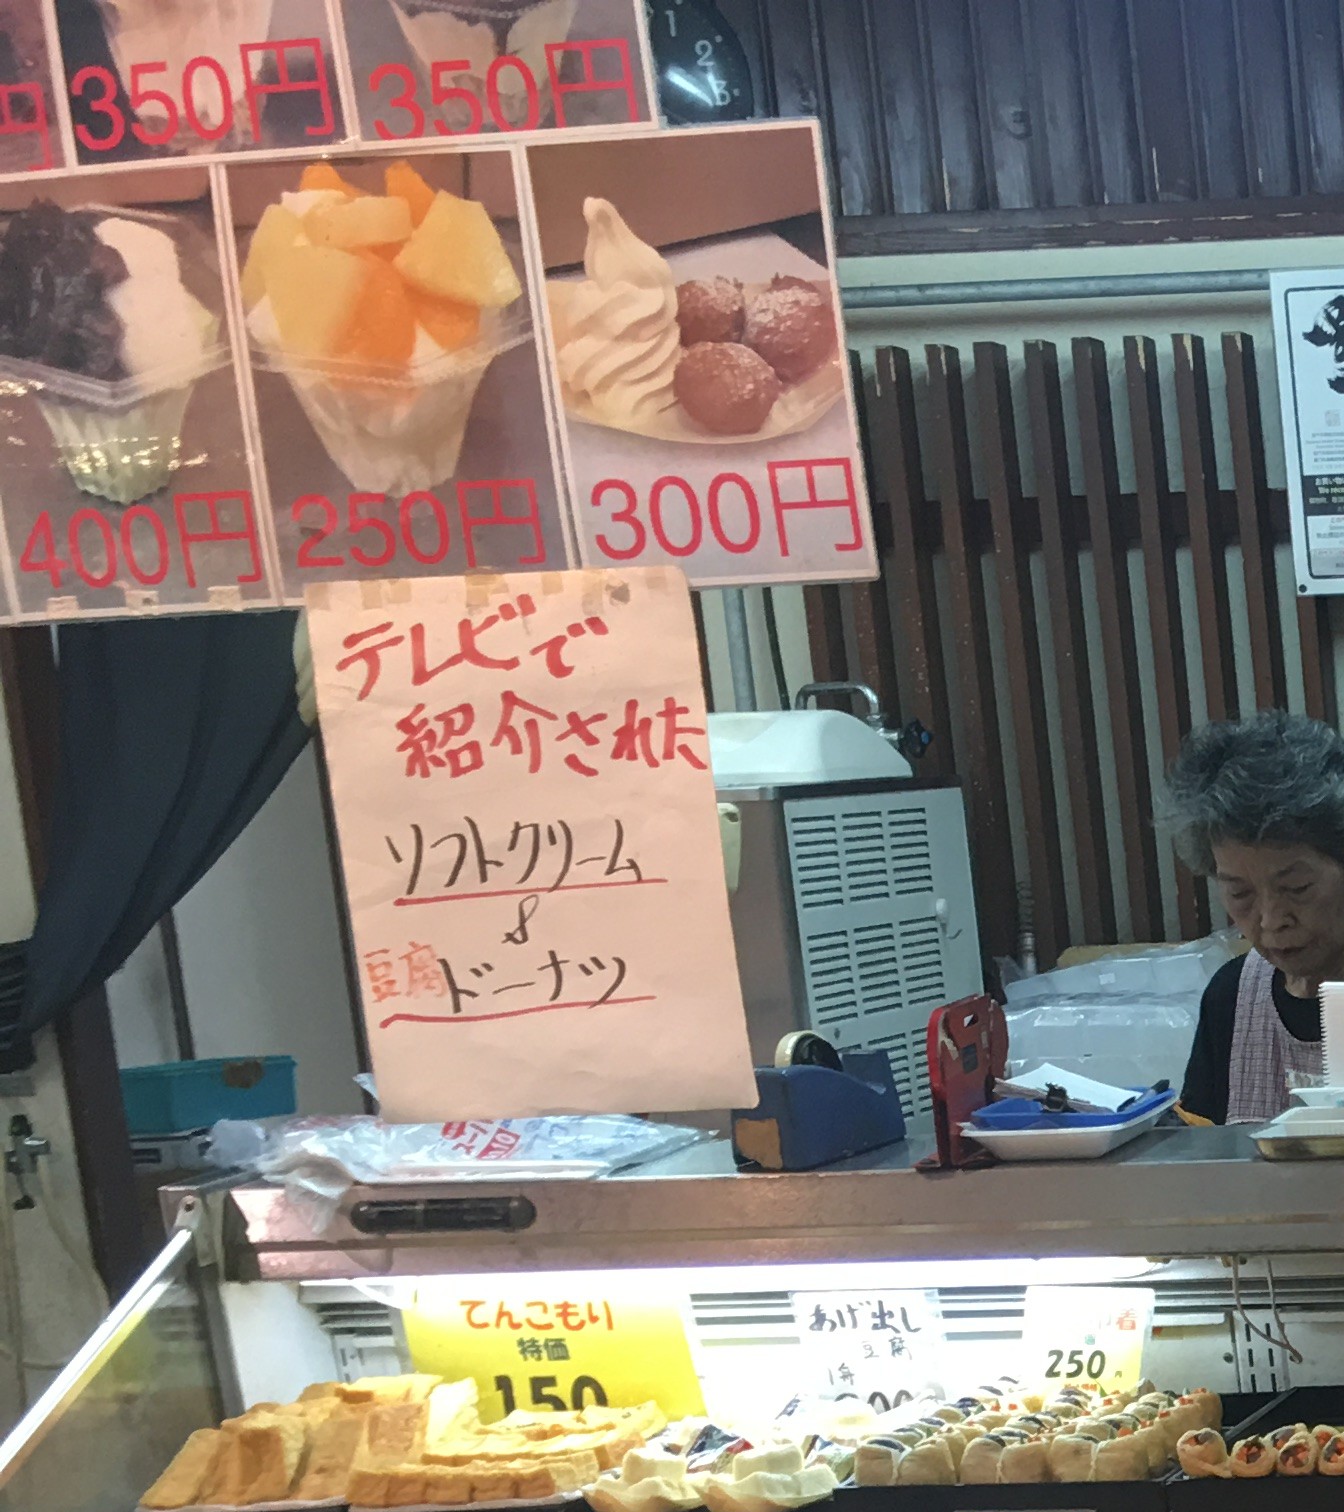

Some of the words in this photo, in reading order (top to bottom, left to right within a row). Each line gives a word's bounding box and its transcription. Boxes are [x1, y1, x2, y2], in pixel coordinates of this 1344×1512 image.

[71, 38, 335, 151] 350円
[368, 37, 640, 142] 350円
[20, 490, 265, 591] 400円
[290, 478, 546, 569] 250円
[591, 457, 865, 562] 300円
[337, 593, 609, 701] テレビで
[395, 690, 708, 779] 紹介された
[385, 816, 644, 896] ソフトクリーム
[459, 1299, 614, 1332] てんこもり
[517, 1337, 571, 1362] 特価
[808, 1300, 923, 1333] あげ出し
[494, 1374, 610, 1416] 150
[1045, 1349, 1107, 1380] 250
